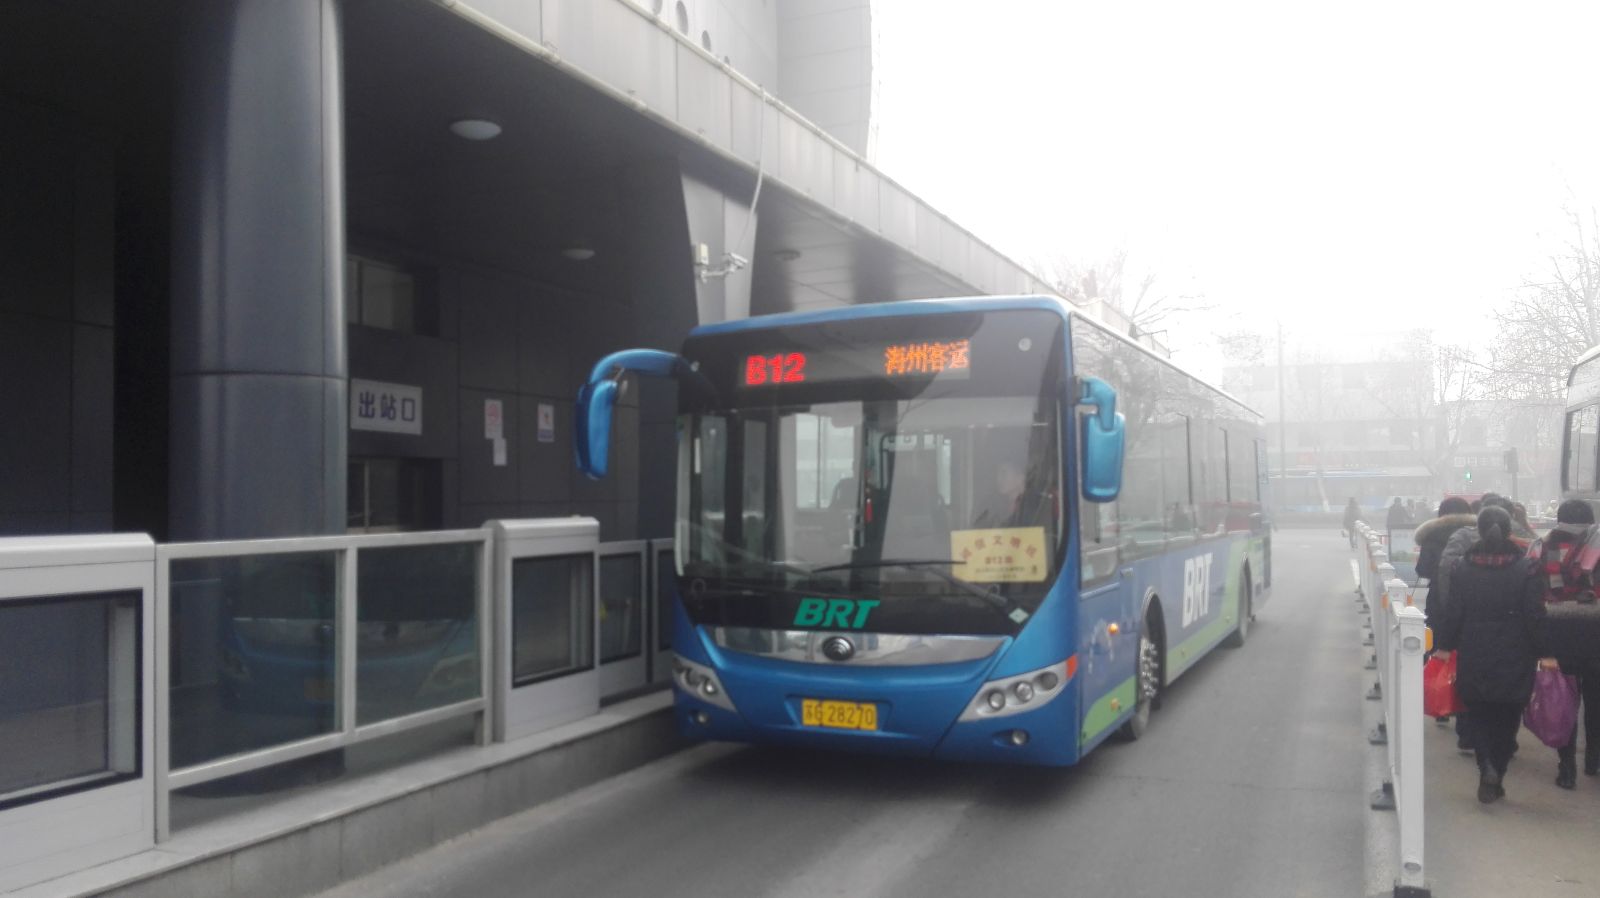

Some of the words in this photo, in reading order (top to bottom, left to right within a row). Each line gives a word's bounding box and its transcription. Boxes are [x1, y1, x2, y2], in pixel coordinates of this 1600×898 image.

[745, 353, 806, 386] B12
[358, 391, 416, 422] 出站口
[1182, 552, 1213, 629] BRT
[793, 597, 880, 629] BRT
